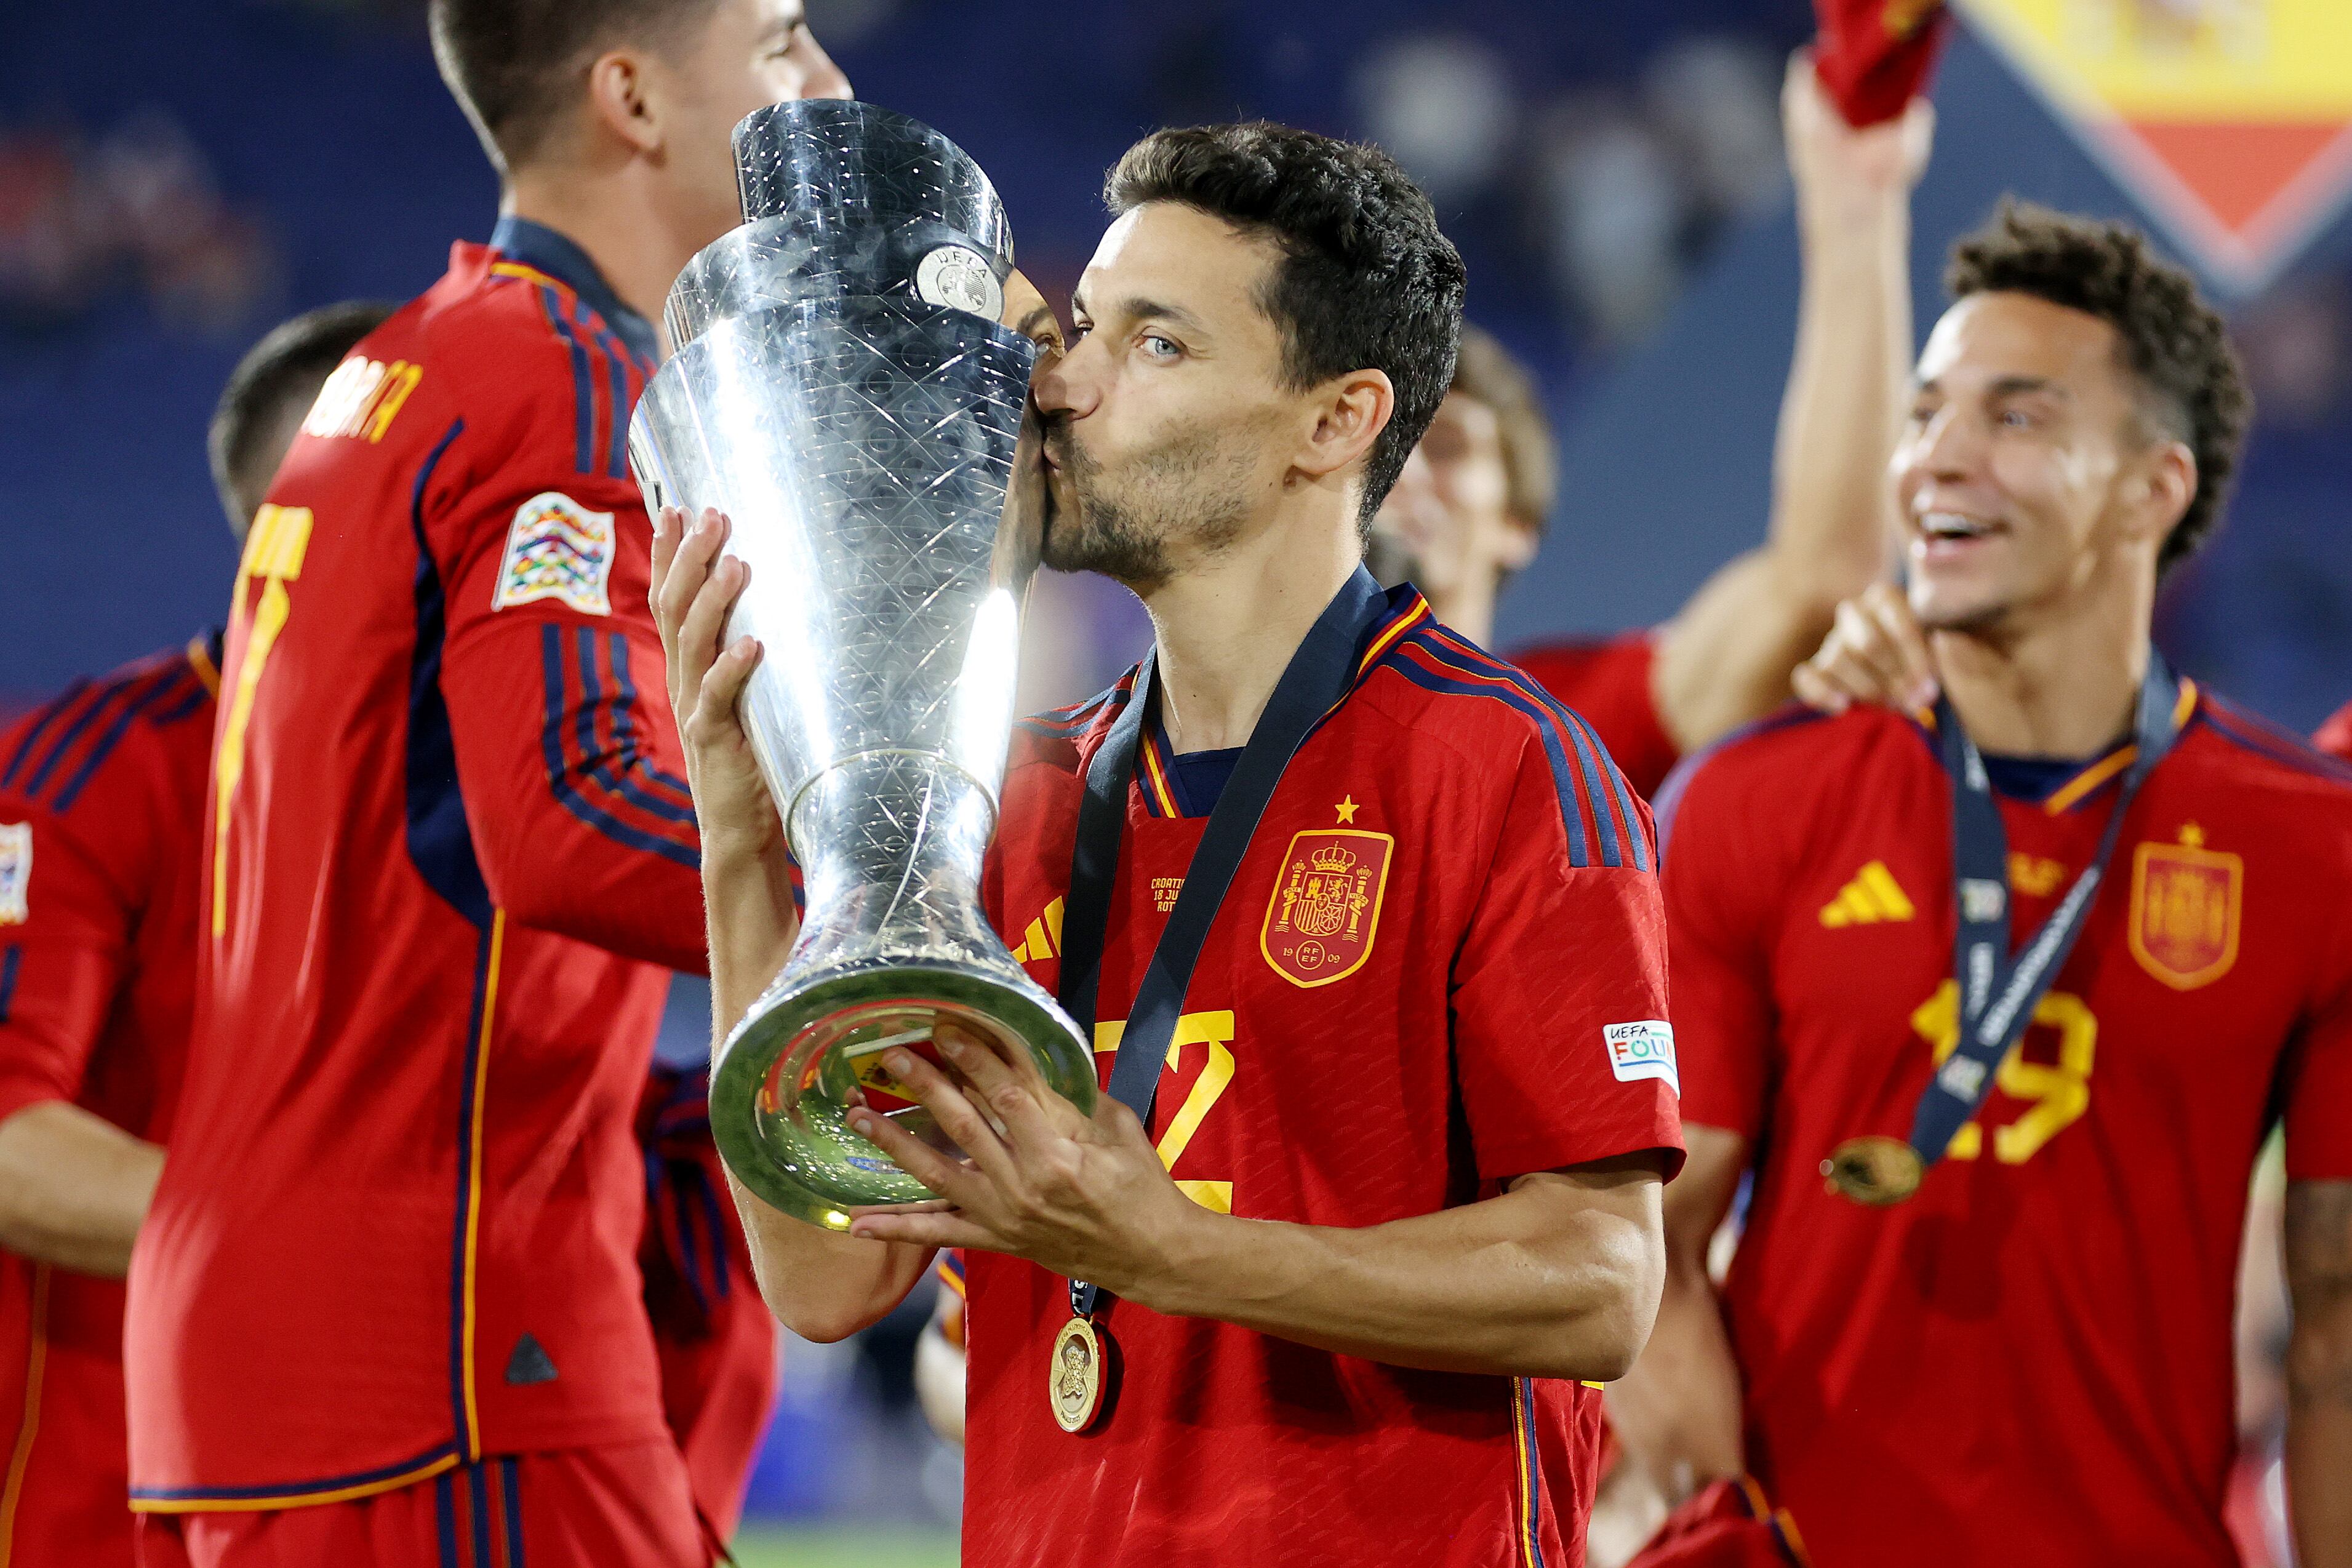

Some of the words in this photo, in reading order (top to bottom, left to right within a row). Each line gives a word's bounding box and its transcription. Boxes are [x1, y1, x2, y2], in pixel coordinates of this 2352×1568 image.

[1153, 890, 1164, 900] 18
[1283, 947, 1293, 956] 19
[1327, 954, 1340, 963] 09
[1610, 1025, 1649, 1039] UEFA
